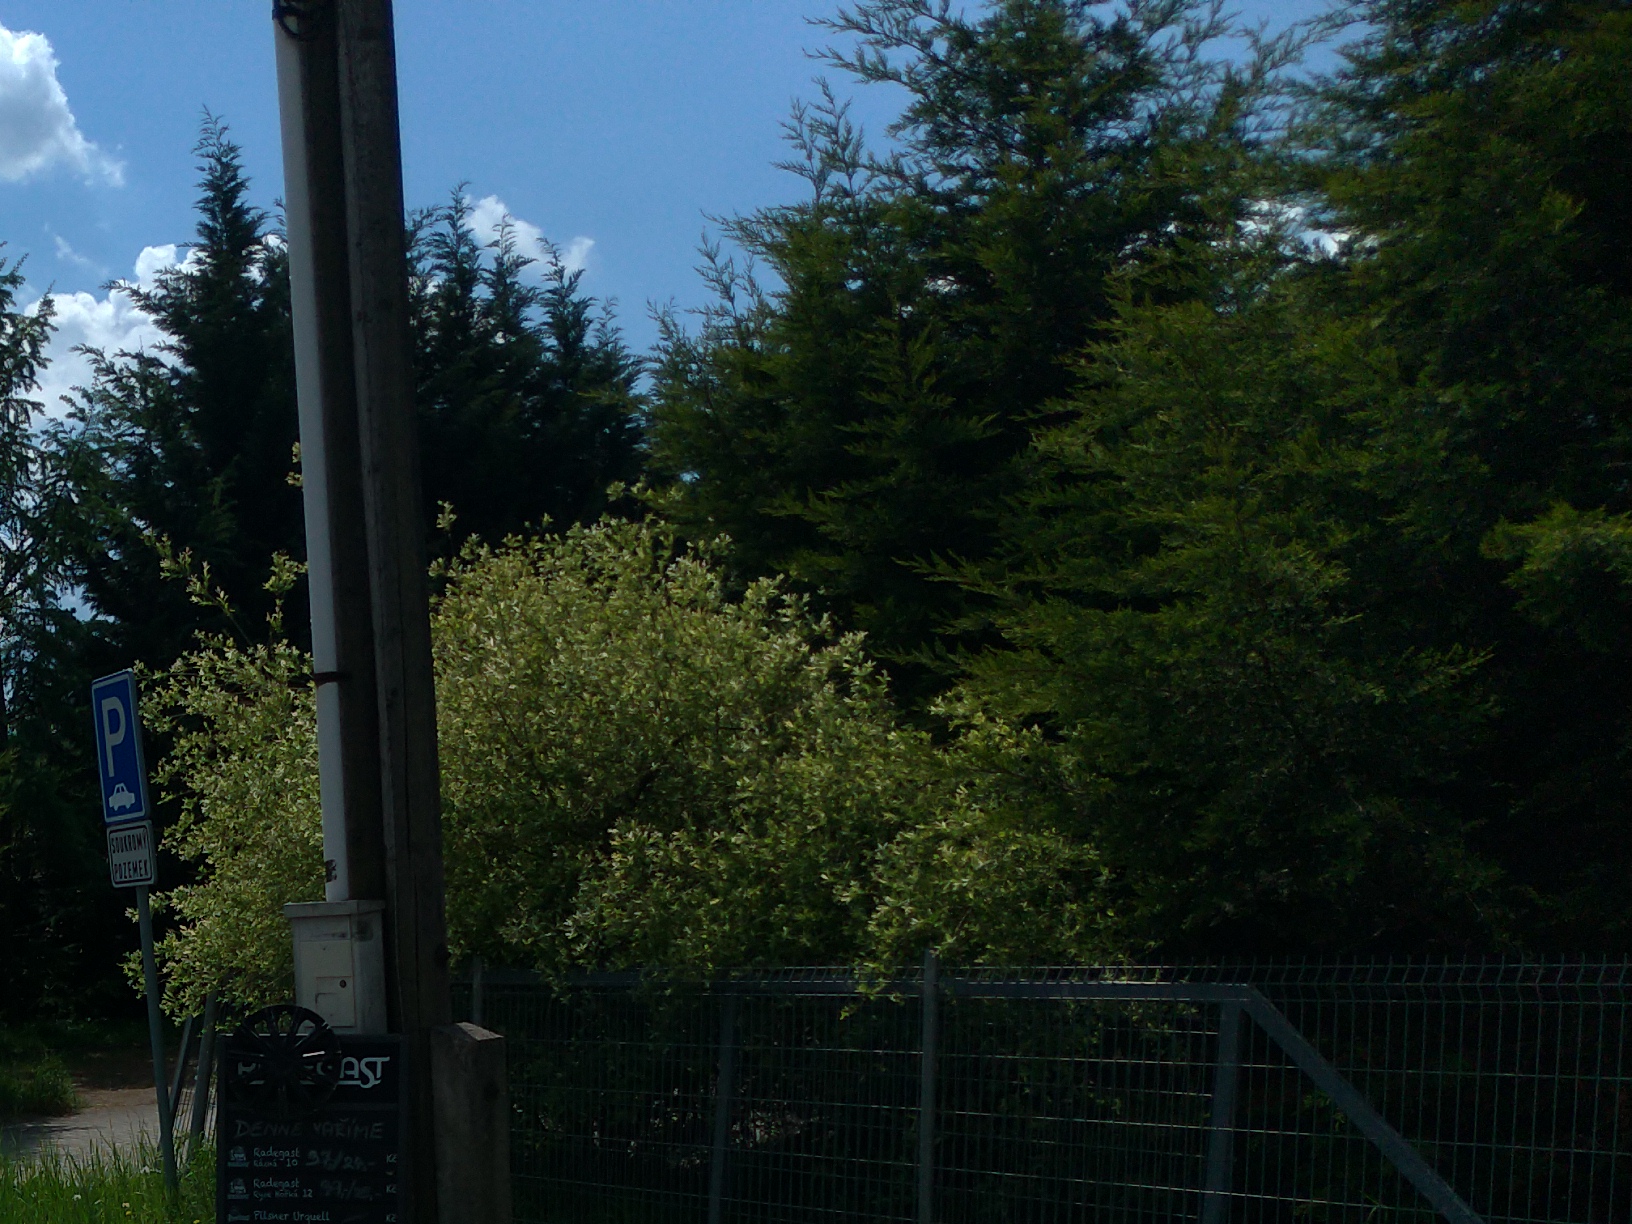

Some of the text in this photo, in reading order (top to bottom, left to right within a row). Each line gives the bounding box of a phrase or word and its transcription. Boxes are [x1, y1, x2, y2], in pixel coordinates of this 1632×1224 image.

[101, 696, 126, 777] P
[114, 859, 148, 880] POZEMEK
[253, 1145, 300, 1160] Radegast
[286, 1157, 298, 1168] 10
[253, 1177, 300, 1191] Radegast
[302, 1188, 313, 1198] 12
[253, 1210, 290, 1221] Pilsner
